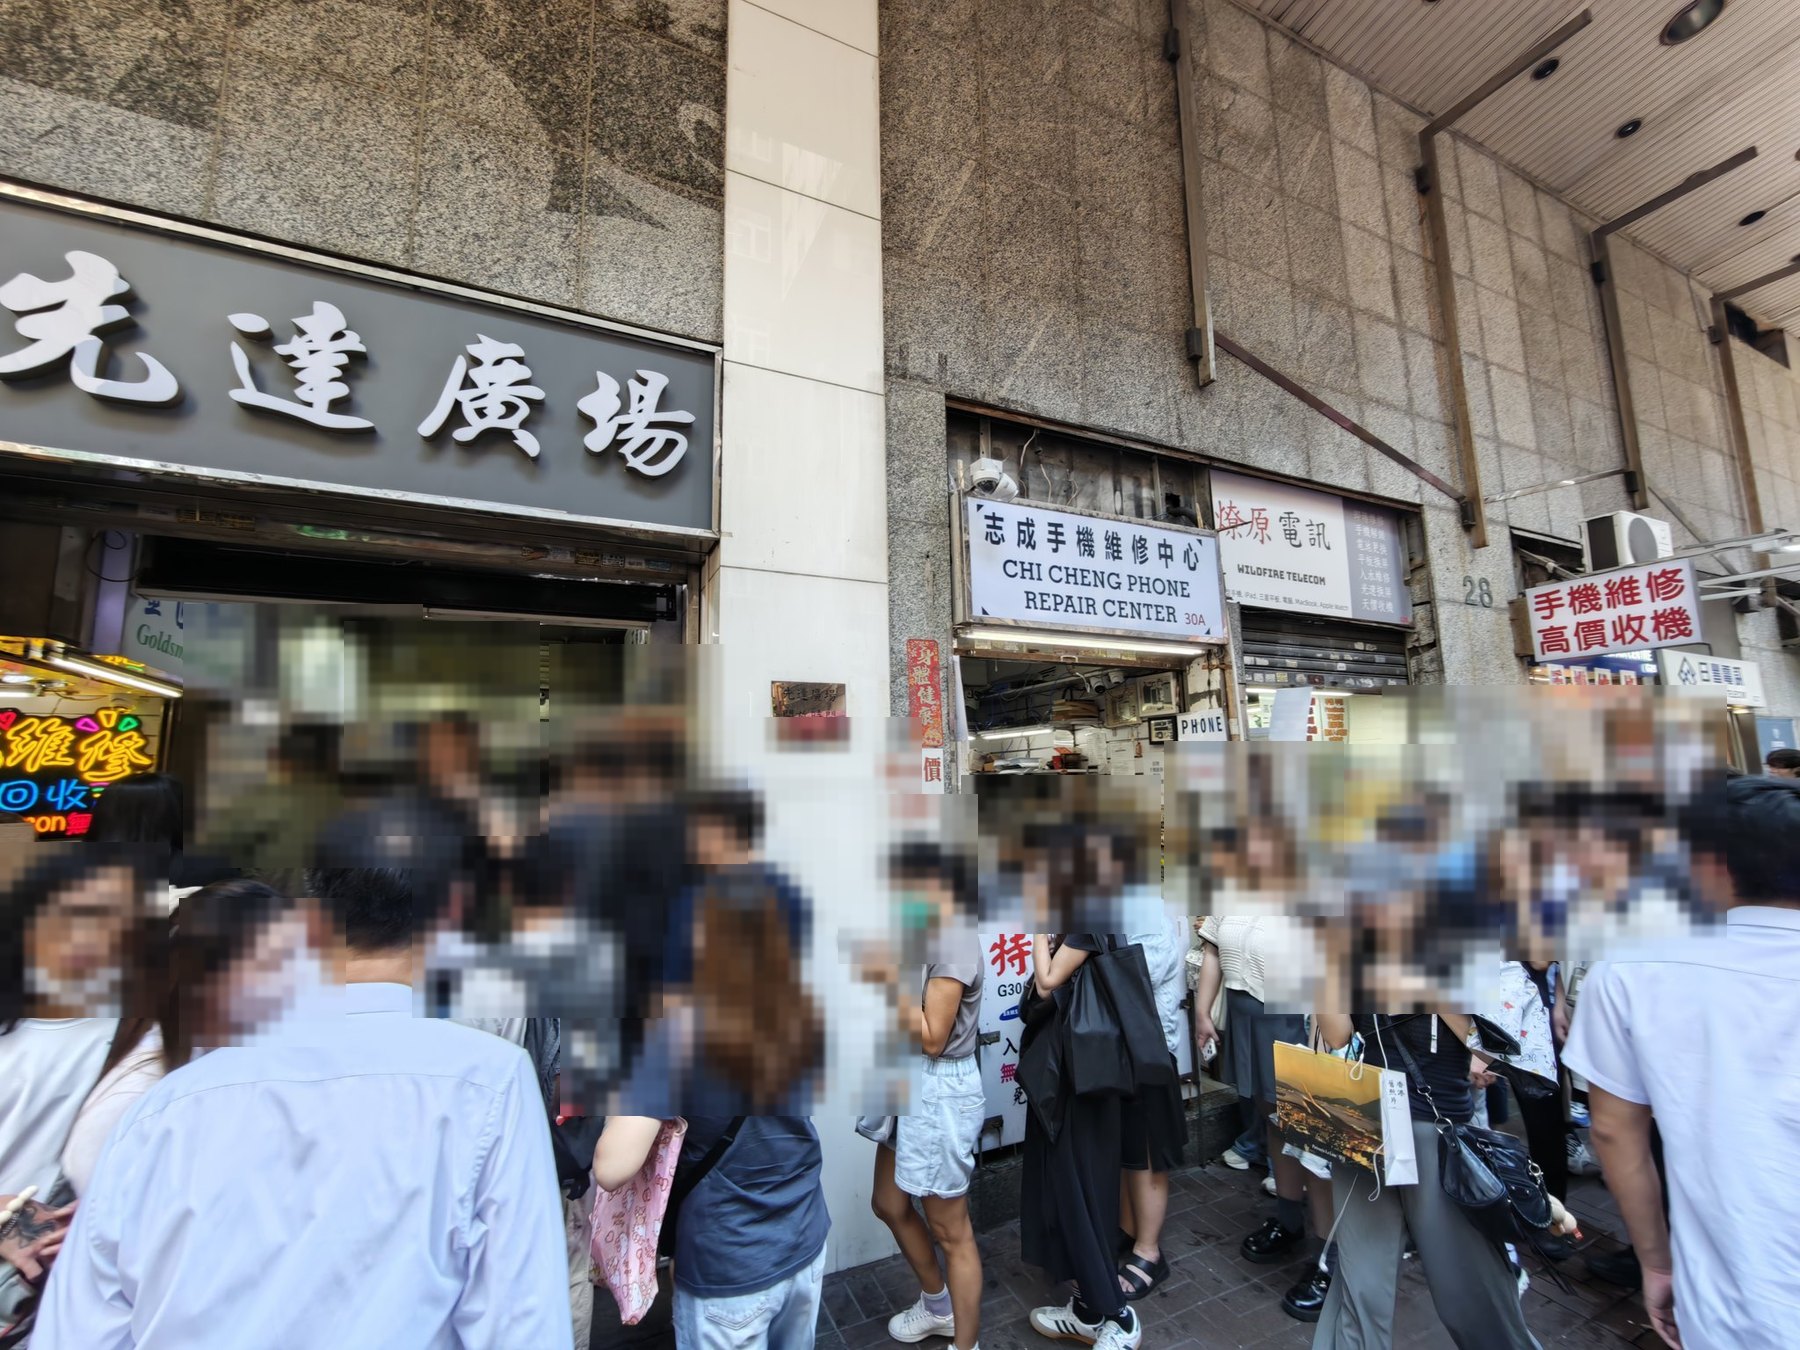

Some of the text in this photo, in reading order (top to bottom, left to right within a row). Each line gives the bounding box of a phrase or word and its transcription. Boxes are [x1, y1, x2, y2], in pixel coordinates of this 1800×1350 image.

[0, 250, 695, 477] 先達廣場
[983, 512, 1199, 571] 志成手機維修中心
[1215, 500, 1331, 550] 燎原電訊
[1002, 559, 1190, 598] CHI CHENG PHONE
[1237, 563, 1326, 586] WILDFIRE TELECOM
[1463, 575, 1493, 608] 28
[1024, 590, 1177, 623] REPAIR CENTER
[1534, 567, 1687, 621] 手機維修
[1185, 613, 1206, 626] 30A
[1537, 605, 1693, 656] 高價收機
[1181, 715, 1222, 735] PHONE
[0, 717, 153, 782] 維修
[924, 756, 942, 783] 價
[0, 779, 89, 812] 回收
